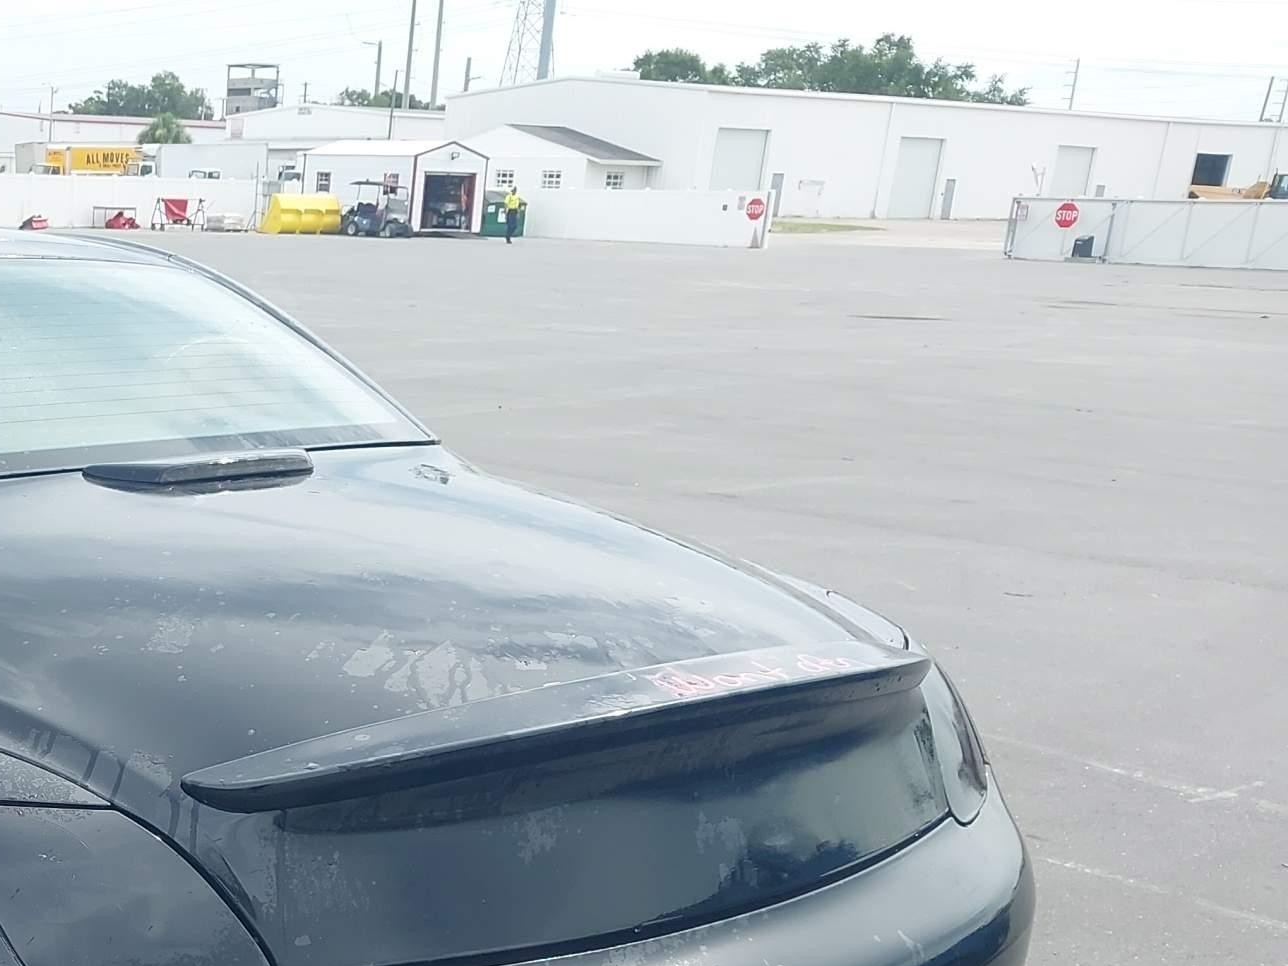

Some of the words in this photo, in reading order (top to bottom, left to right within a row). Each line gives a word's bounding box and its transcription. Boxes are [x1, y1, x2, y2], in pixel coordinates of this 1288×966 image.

[86, 152, 100, 165] ALL
[102, 152, 130, 164] MOVES
[748, 204, 764, 214] STOP
[1056, 210, 1078, 221] STOP
